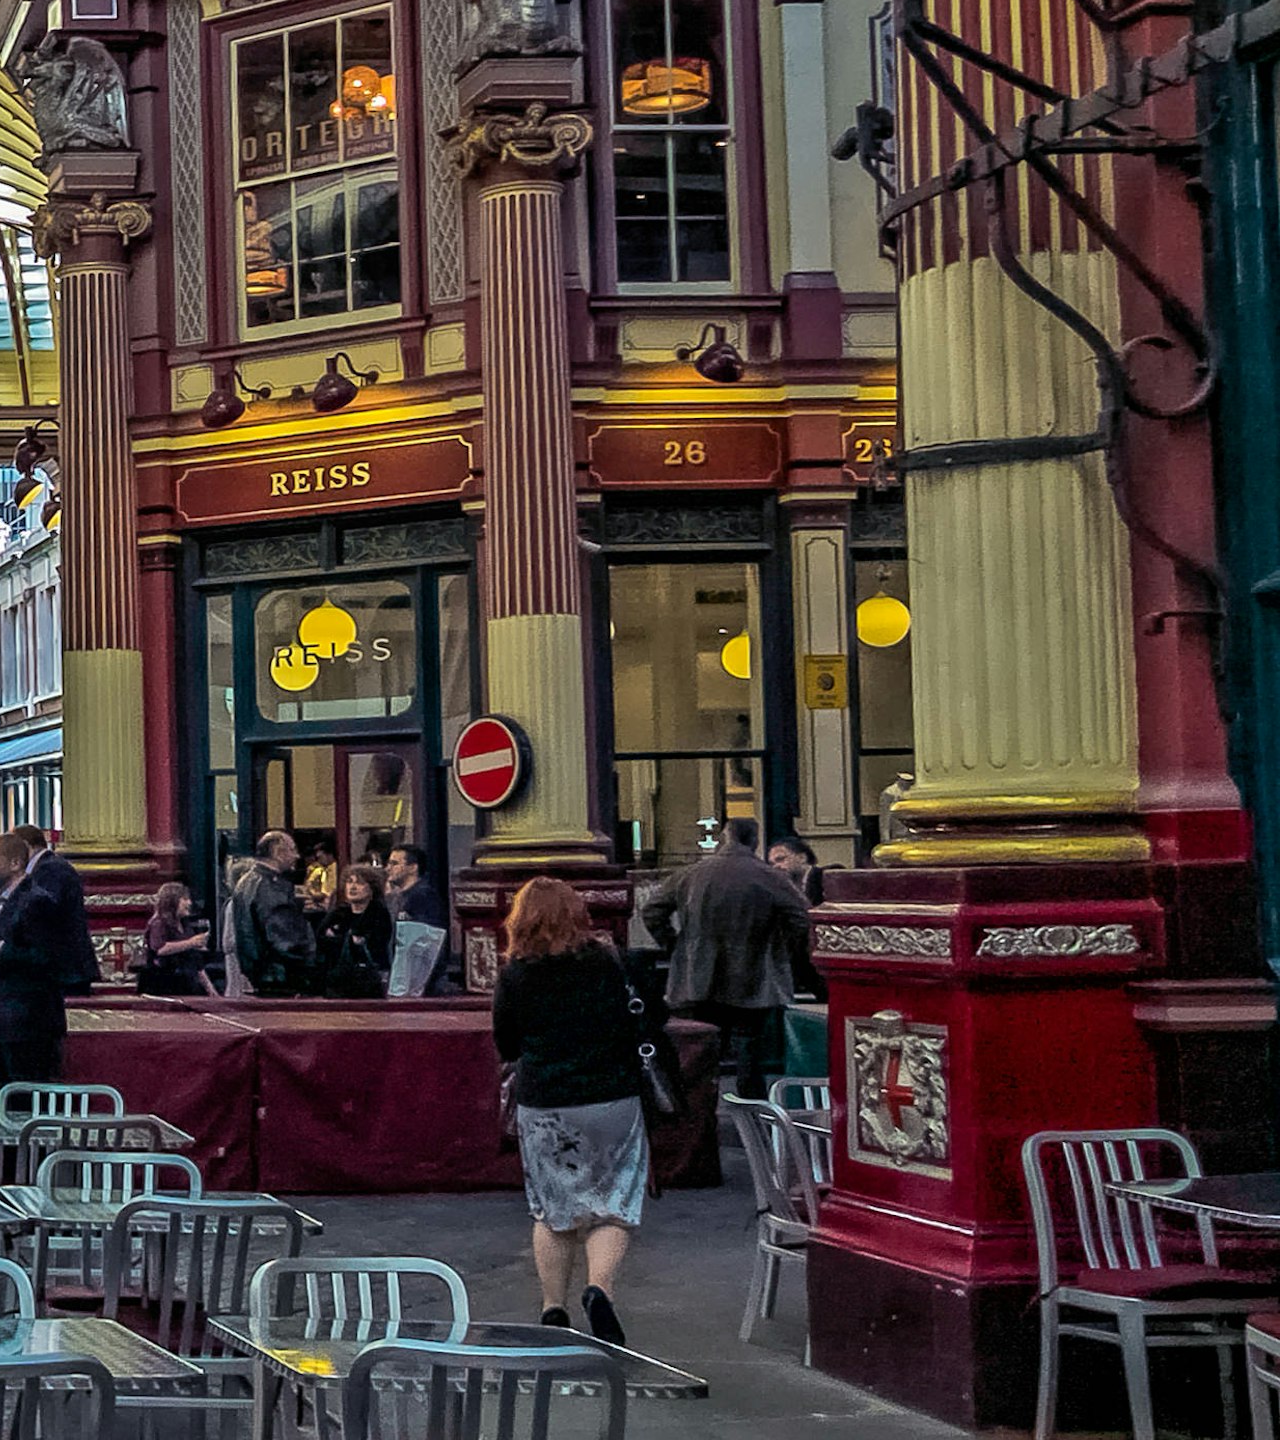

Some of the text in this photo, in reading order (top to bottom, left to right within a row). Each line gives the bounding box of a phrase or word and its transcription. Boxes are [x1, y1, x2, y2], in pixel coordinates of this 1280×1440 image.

[663, 441, 707, 465] 26
[270, 462, 371, 496] REISS
[273, 638, 391, 668] REISS
